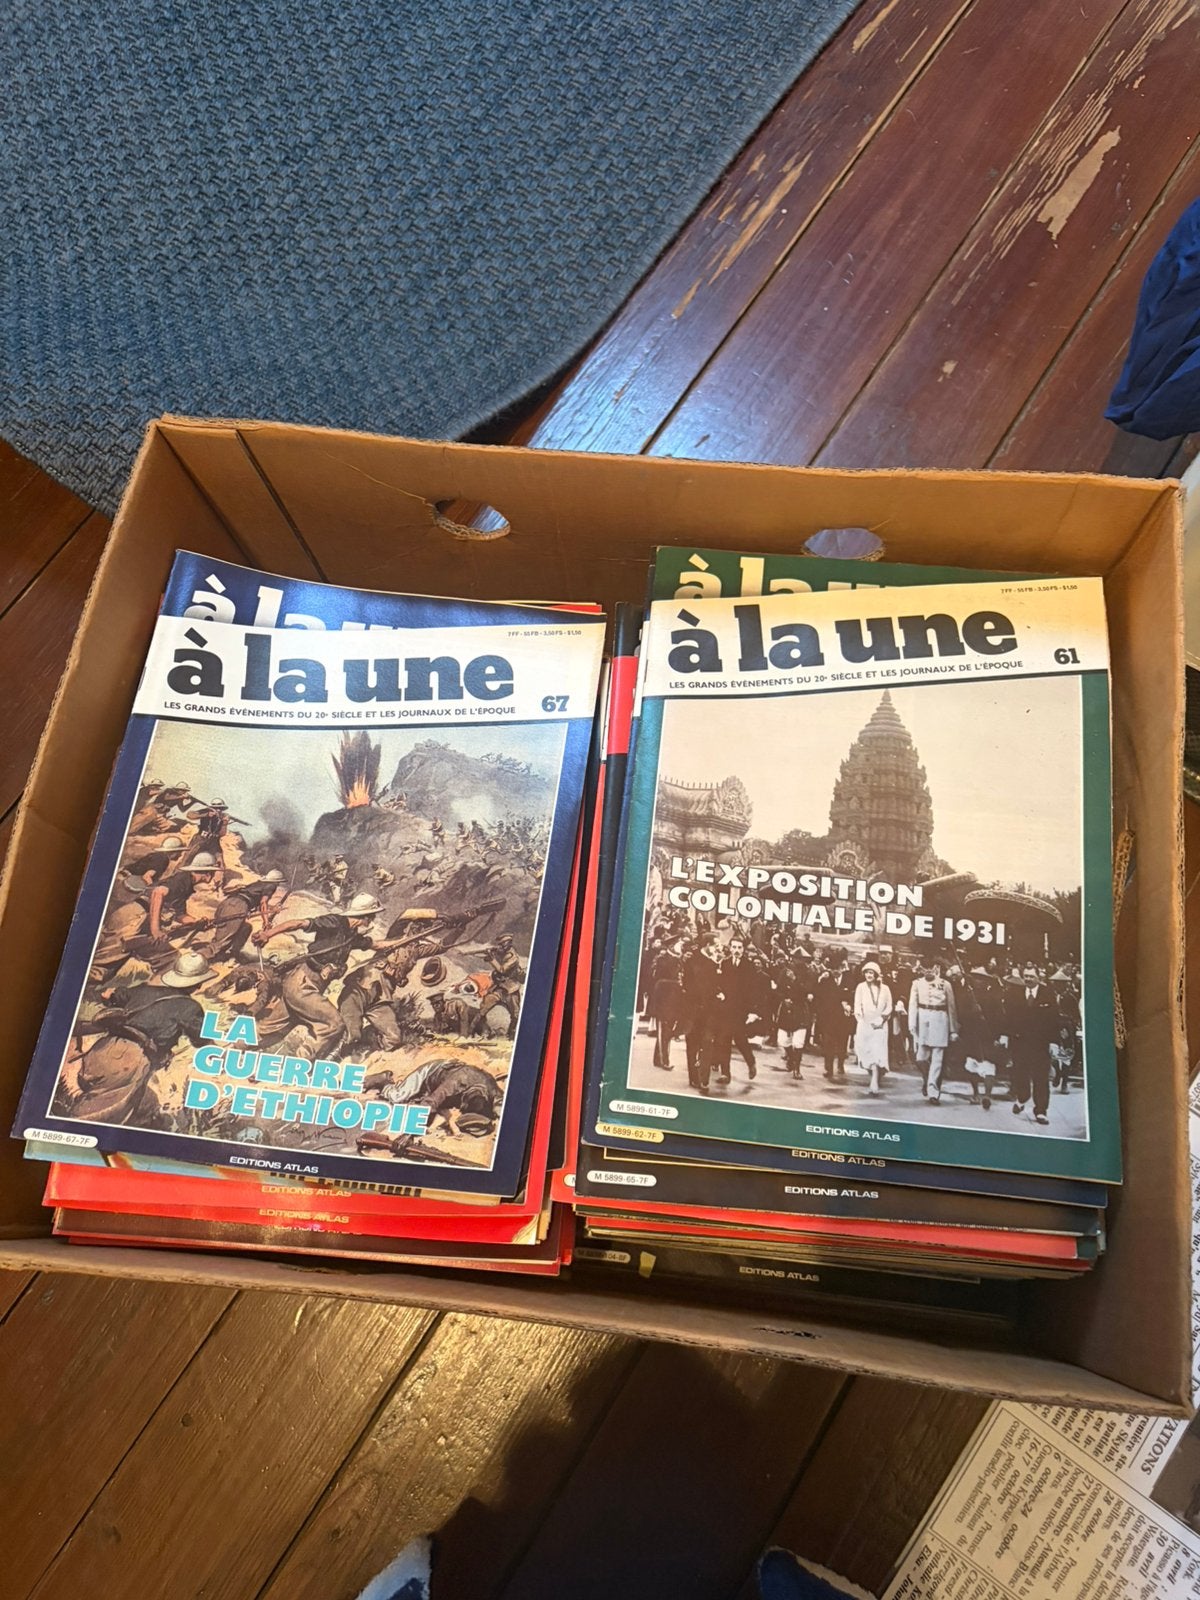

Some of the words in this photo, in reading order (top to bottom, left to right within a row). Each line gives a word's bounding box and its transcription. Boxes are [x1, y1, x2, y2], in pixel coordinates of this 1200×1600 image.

[667, 608, 723, 673] à
[734, 604, 825, 672] la
[834, 610, 1018, 664] une
[167, 627, 224, 698] à
[240, 633, 328, 704] la
[343, 654, 514, 703] une
[1054, 648, 1080, 665] 61
[688, 681, 728, 689] GRANDS
[797, 675, 811, 684] DU
[831, 670, 863, 681] SIÈCLE
[865, 670, 877, 678] ET
[880, 669, 897, 677] LES
[900, 665, 956, 677] JOURNAUX
[958, 664, 972, 672] DE
[974, 660, 1024, 671] L'ÉPOQUE
[164, 701, 181, 710] LES
[184, 703, 226, 714] GRANDS
[297, 711, 312, 719] DU
[331, 709, 363, 719] SIÈCLE
[380, 710, 396, 718] LES
[398, 708, 452, 719] JOURNAUX
[455, 708, 467, 716] DE
[470, 705, 516, 715] L'ÉPOQUE
[541, 695, 570, 712] 67
[671, 856, 924, 908] L'EXPOSITION
[669, 886, 875, 933] COLONIALE
[886, 911, 934, 938] DE
[944, 917, 1006, 945] 1931
[200, 1010, 259, 1046] LA
[192, 1044, 367, 1094] GUERRE
[184, 1079, 431, 1136] D'ETHIOPIE
[626, 1104, 671, 1117] 5899-61-7F
[42, 1133, 91, 1145] 5899-67-7F
[612, 1127, 657, 1140] 5899-62-7F
[805, 1125, 860, 1138] EDITIONS
[862, 1131, 900, 1142] ATLAS
[229, 1156, 282, 1169] EDITIONS
[284, 1163, 319, 1174] ATLAS
[792, 1149, 845, 1163] EDITIONS
[847, 1156, 886, 1168] ATLAS
[261, 1185, 314, 1196] EDITIONS
[316, 1188, 351, 1197] ATLAS
[784, 1186, 838, 1197] EDITIONS
[840, 1189, 879, 1199] ATLAS
[258, 1208, 312, 1220] EDITIONS
[313, 1212, 349, 1224] ATLAS
[739, 1266, 785, 1279] EDITIONS
[787, 1271, 820, 1282] ATLAS
[1051, 1407, 1066, 1426] tion
[1092, 1416, 1103, 1432] est
[1125, 1413, 1149, 1451] remière
[1000, 1420, 1019, 1449] conflit
[1014, 1428, 1030, 1449] choc
[1071, 1427, 1084, 1443] vol
[1092, 1420, 1116, 1456] spatiale
[1102, 1429, 1128, 1462] Skylab.
[1022, 1436, 1041, 1466] 16-17
[1029, 1441, 1052, 1474] Guerre
[1114, 1453, 1127, 1472] sta-
[954, 1448, 1005, 1522] israélo-palestinien.
[991, 1451, 1015, 1489] pétrolier
[1049, 1465, 1069, 1488] Paris.
[1061, 1467, 1084, 1497] bombe
[997, 1469, 1020, 1504] octobre
[1020, 1467, 1051, 1517] octobre-24
[966, 1492, 991, 1530] résultant
[1000, 1485, 1027, 1522] Kippour.
[1053, 1488, 1086, 1536] Novembre
[1070, 1481, 1102, 1534] commercial
[1101, 1498, 1123, 1529] seillers.
[1118, 1506, 1135, 1528] deux
[1039, 1508, 1057, 1534] métro
[1080, 1507, 1102, 1542] octobre
[1131, 1514, 1146, 1533] doit
[967, 1520, 992, 1556] Premier
[995, 1523, 1017, 1558] octobre
[1100, 1543, 1113, 1559] ses
[1111, 1532, 1134, 1570] accepter
[1126, 1525, 1158, 1566] Watergate.
[915, 1544, 932, 1566] Elsa
[919, 1541, 947, 1584] Nathalie
[1008, 1534, 1044, 1588] Louis-Blanc
[1029, 1542, 1052, 1578] Attentat
[1043, 1544, 1069, 1579] l'Airbus
[1138, 1551, 1154, 1578] avril
[1156, 1539, 1180, 1572] Picasso
[1051, 1556, 1077, 1592] Premier
[1166, 1558, 1181, 1584] avril
